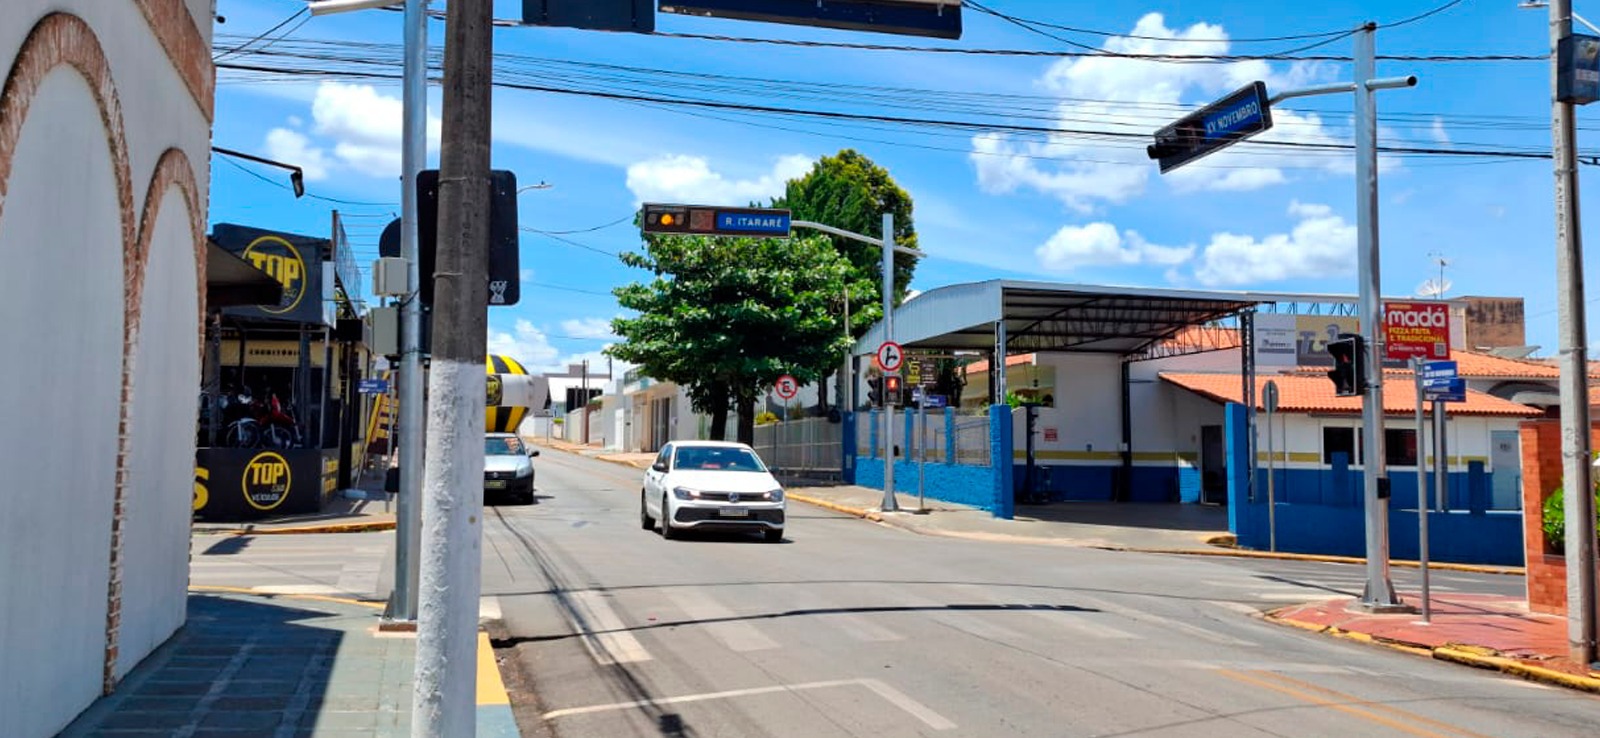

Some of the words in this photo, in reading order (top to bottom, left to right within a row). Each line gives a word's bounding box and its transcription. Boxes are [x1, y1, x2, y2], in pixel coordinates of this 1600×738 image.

[1217, 101, 1258, 129] NOVEMBRO
[725, 216, 735, 227] R.
[738, 217, 782, 228] ITARARÉ
[1388, 306, 1445, 328] madá
[250, 462, 284, 485] TOP
